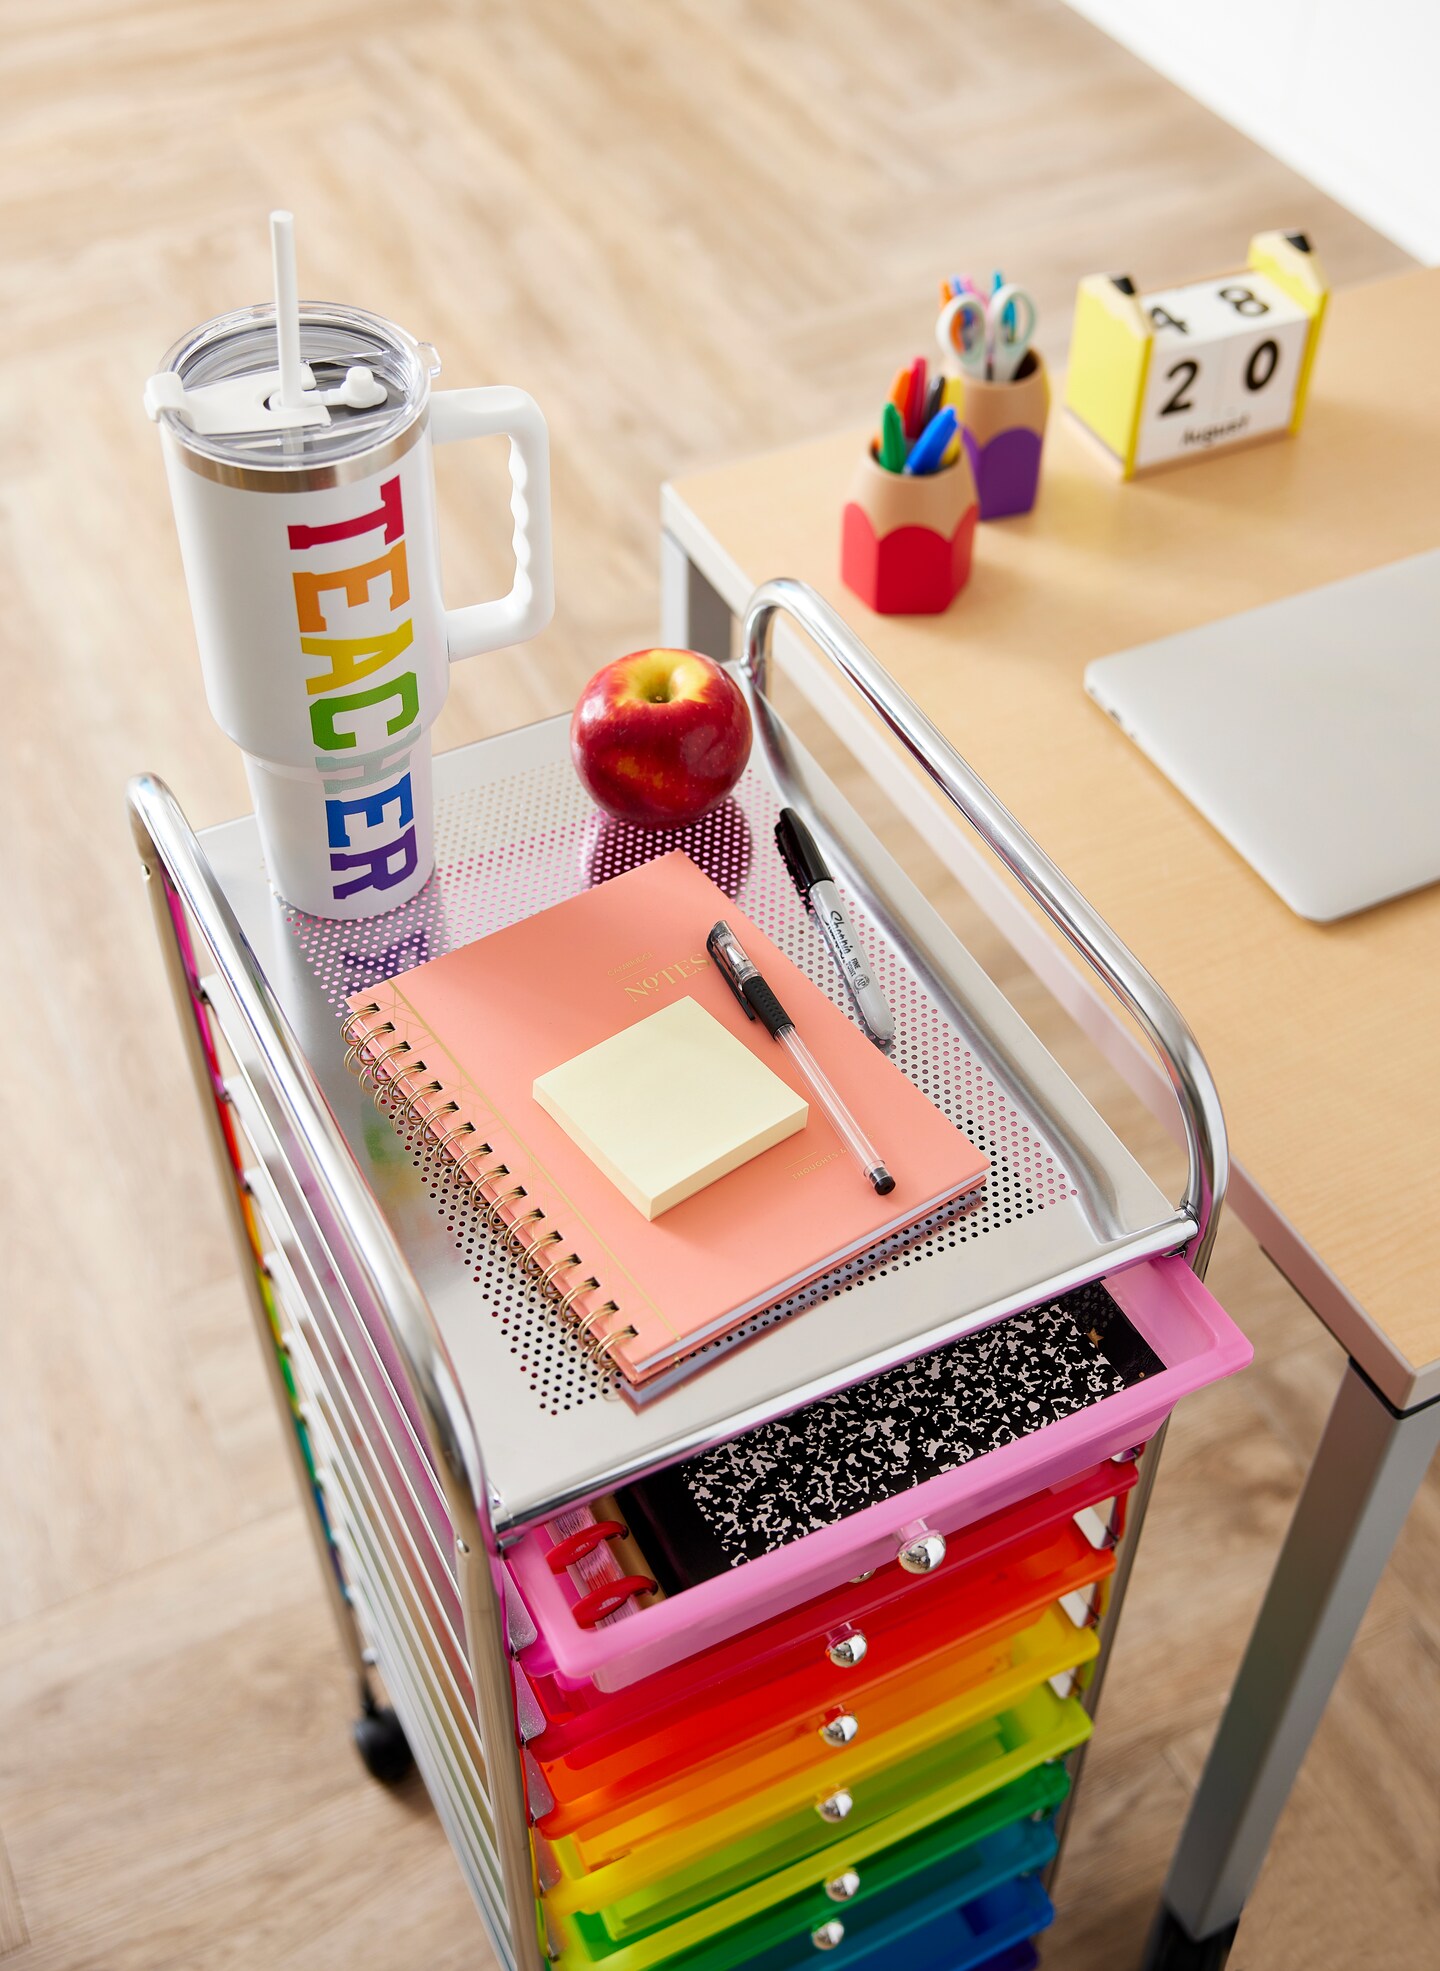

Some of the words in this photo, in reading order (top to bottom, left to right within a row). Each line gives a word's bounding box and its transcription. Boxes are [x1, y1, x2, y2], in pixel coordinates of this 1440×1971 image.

[287, 474, 423, 901] TEACHER
[623, 953, 711, 1002] NOTES
[791, 1152, 839, 1180] THOUGHTS
